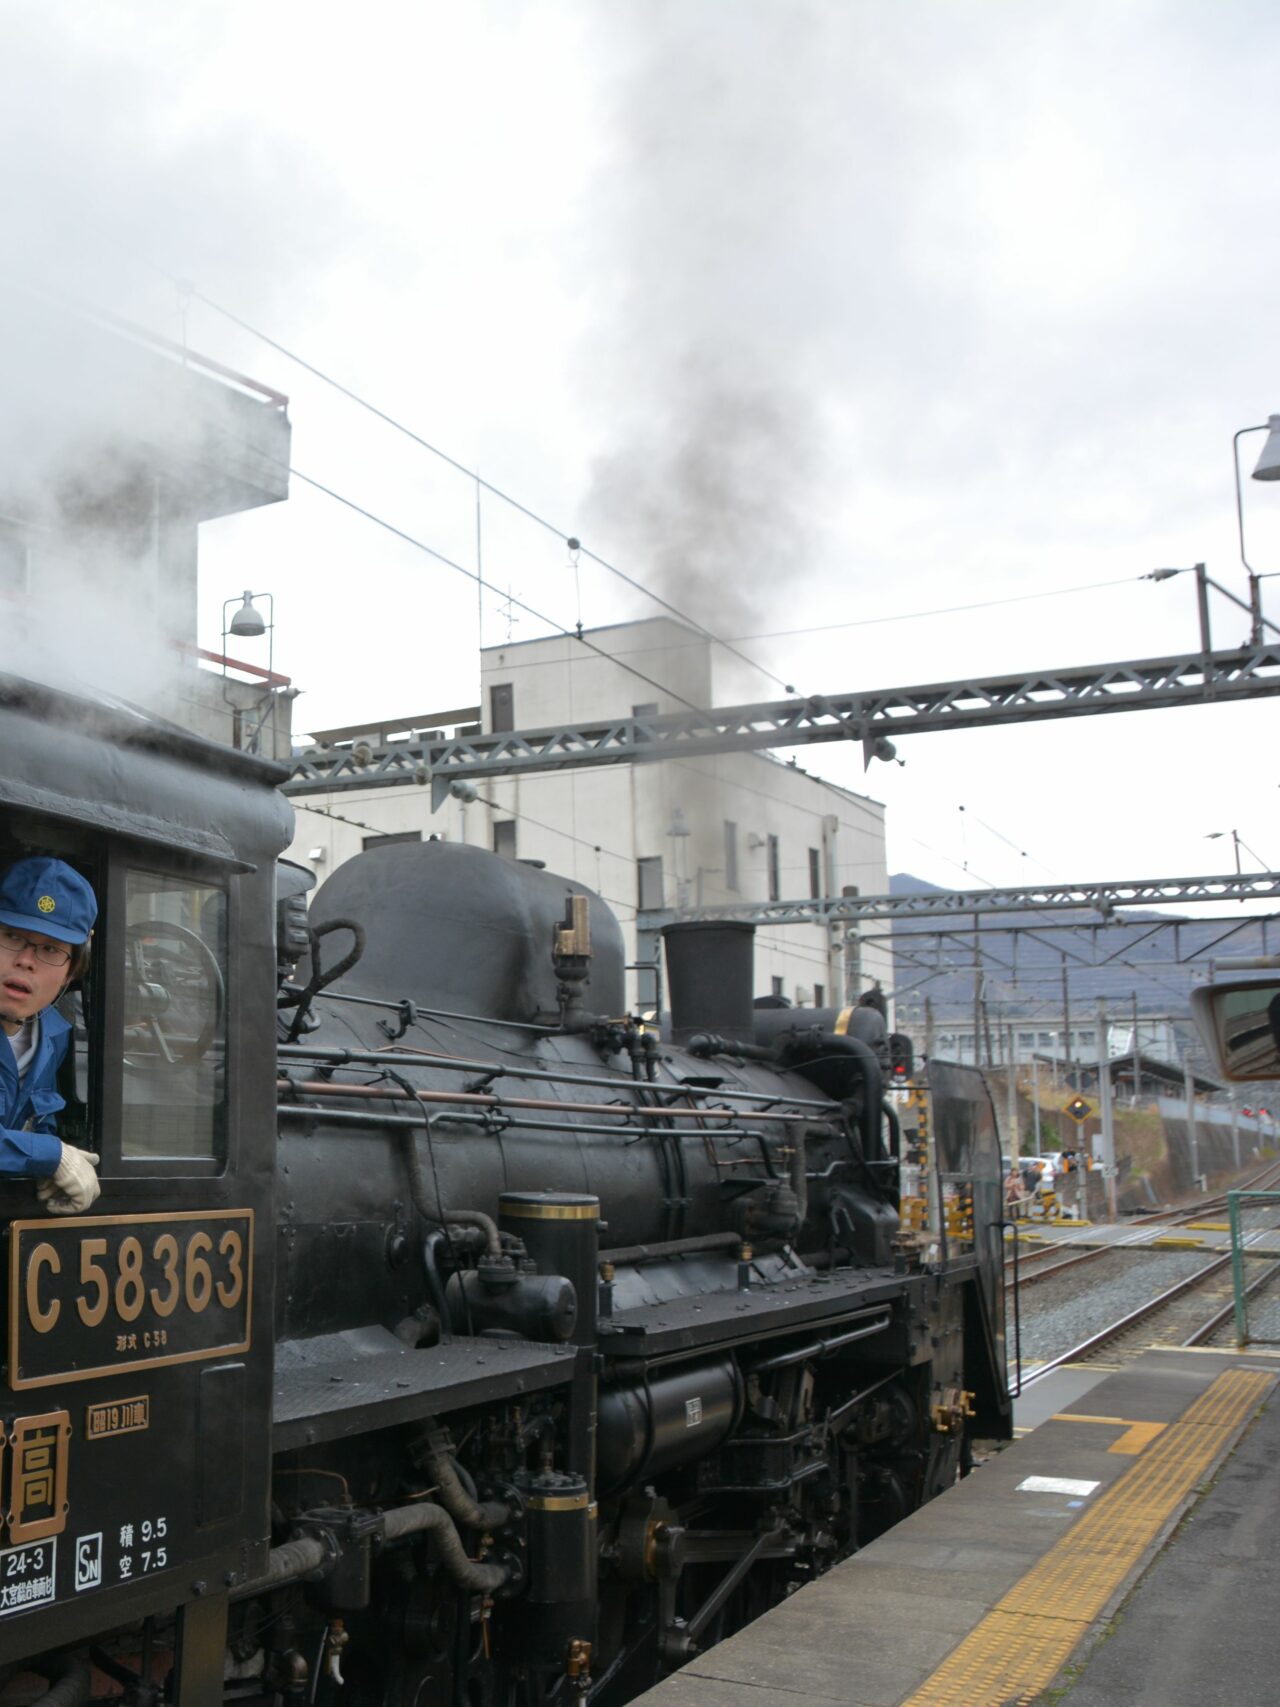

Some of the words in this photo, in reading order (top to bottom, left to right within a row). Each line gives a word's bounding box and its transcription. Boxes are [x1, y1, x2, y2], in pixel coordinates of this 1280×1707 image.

[21, 1428, 57, 1514] 高
[119, 1523, 134, 1548] 積
[141, 1517, 168, 1543] 9.5
[6, 1547, 45, 1577] 24-3
[119, 1555, 133, 1579] 空
[141, 1547, 168, 1572] 7.5
